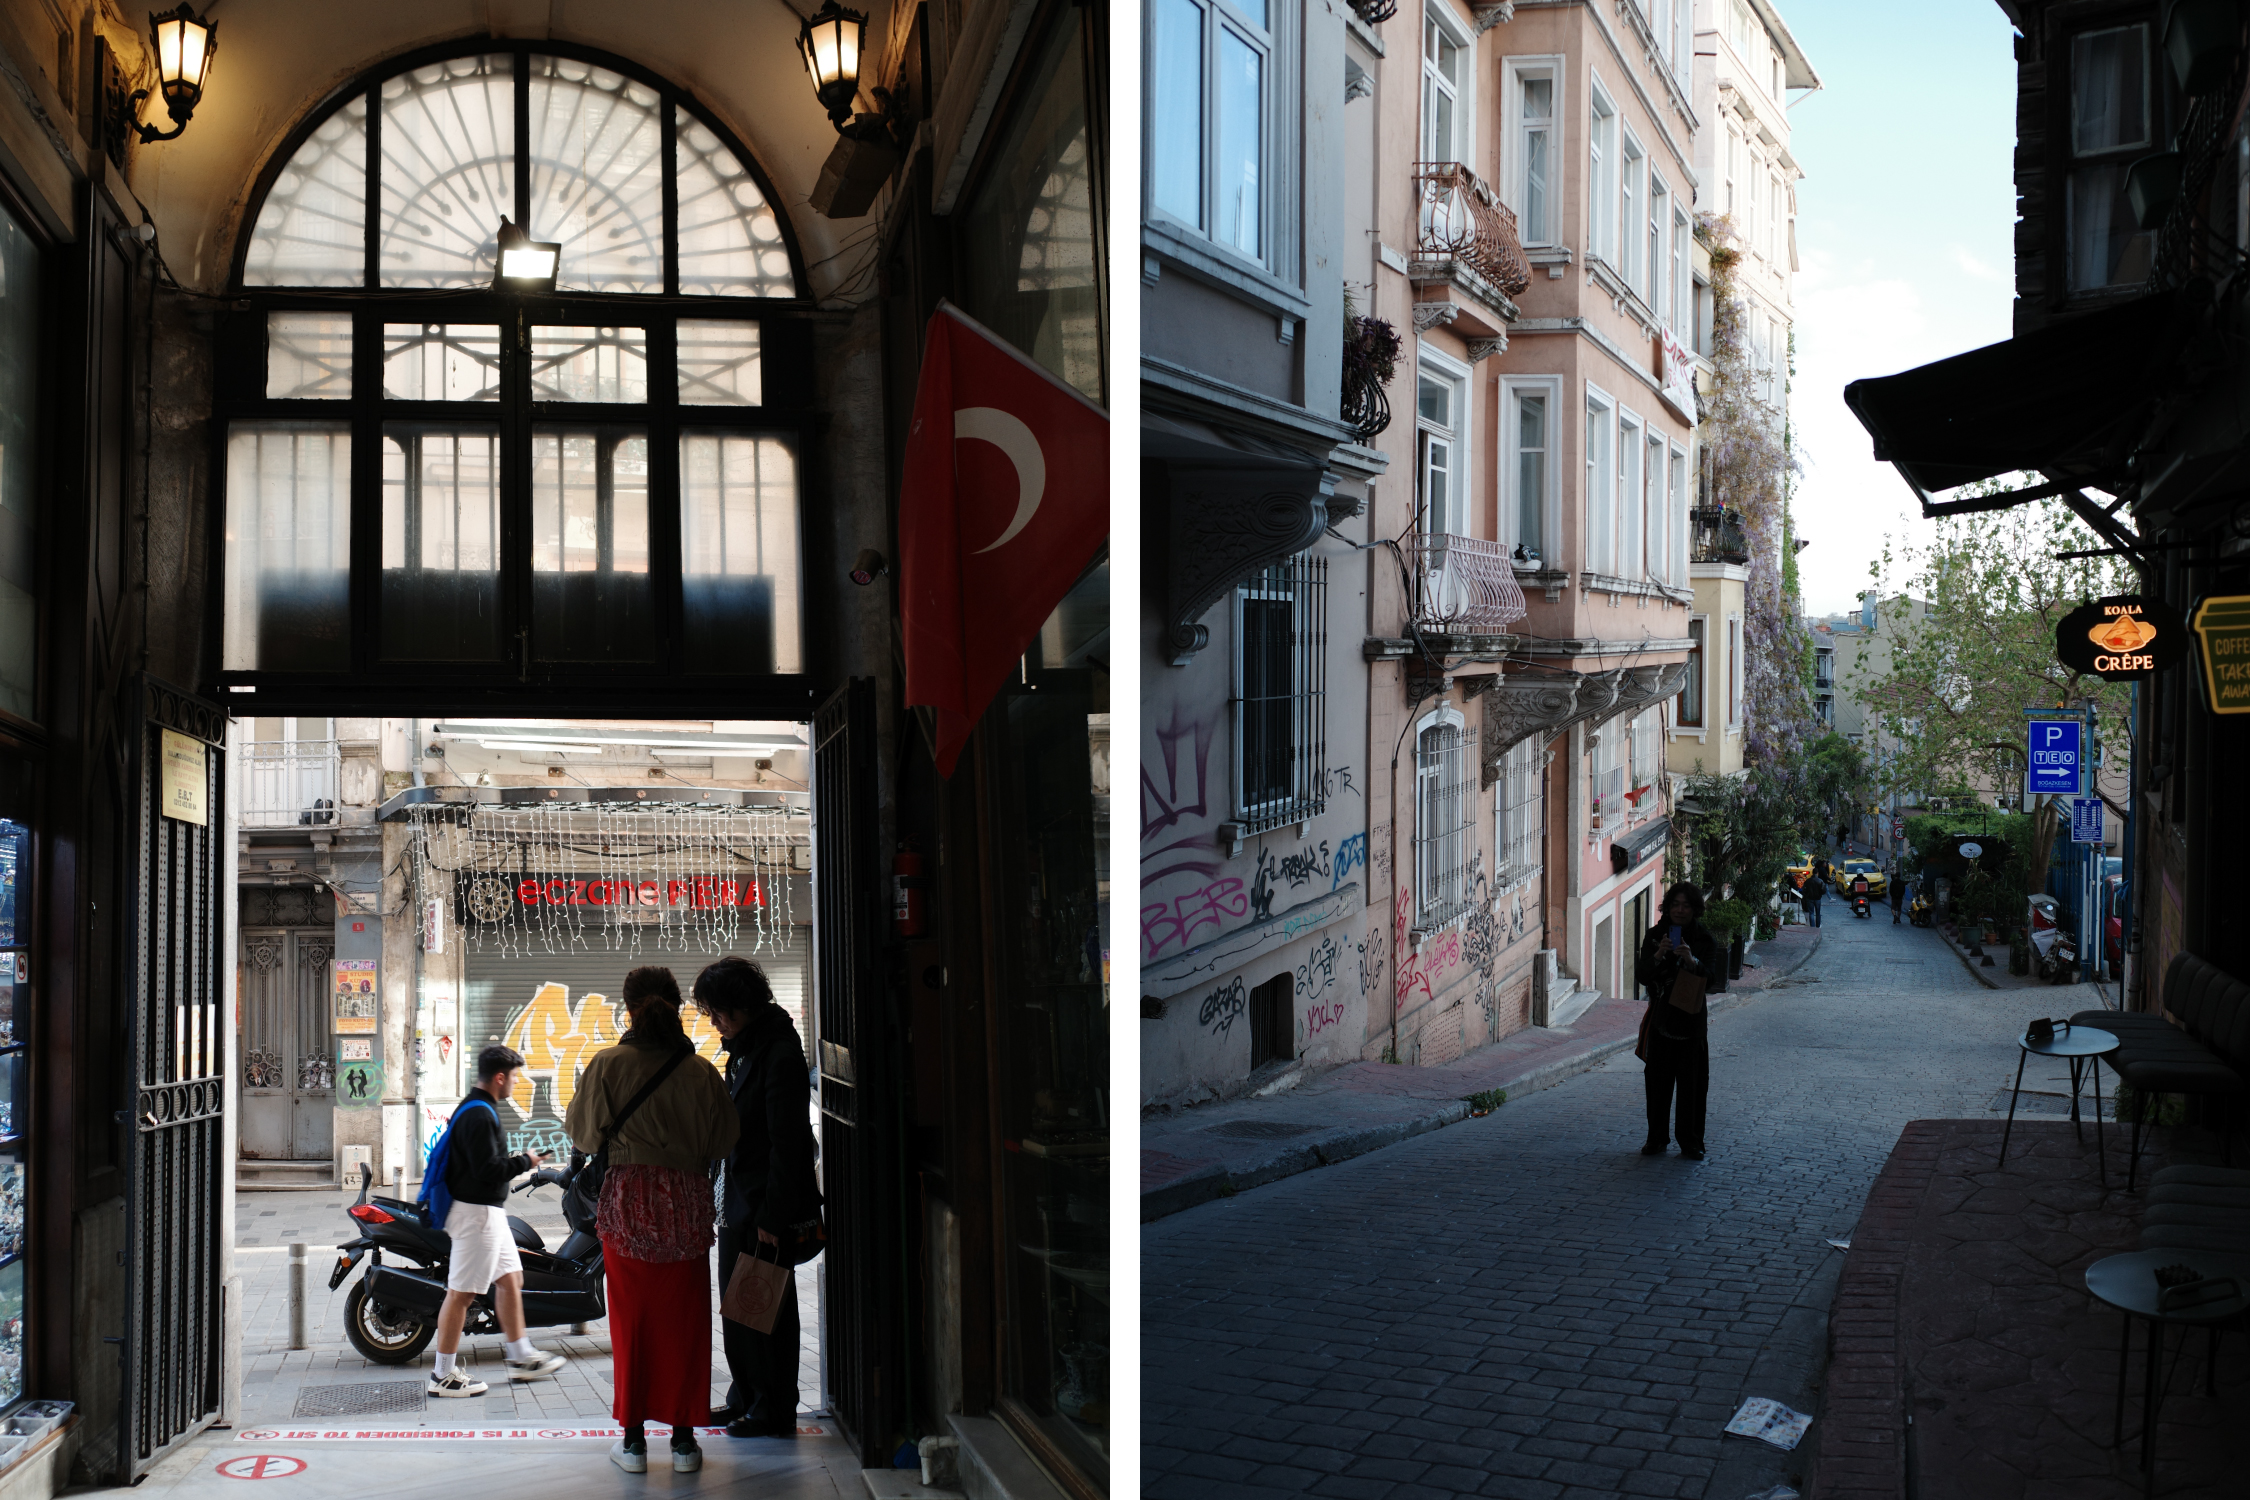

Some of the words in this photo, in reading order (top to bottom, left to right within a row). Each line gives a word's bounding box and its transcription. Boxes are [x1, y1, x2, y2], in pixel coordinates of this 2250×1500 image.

[2103, 604, 2143, 616] KOALA
[2046, 726, 2063, 747] P
[2036, 752, 2073, 763] TEO
[516, 879, 661, 906] eczane
[667, 877, 768, 908] PERA
[283, 1431, 318, 1439] SIT
[325, 1431, 350, 1439] TO
[356, 1431, 475, 1439] FORBIDDEN
[482, 1430, 502, 1438] IS
[508, 1430, 528, 1438] IT
